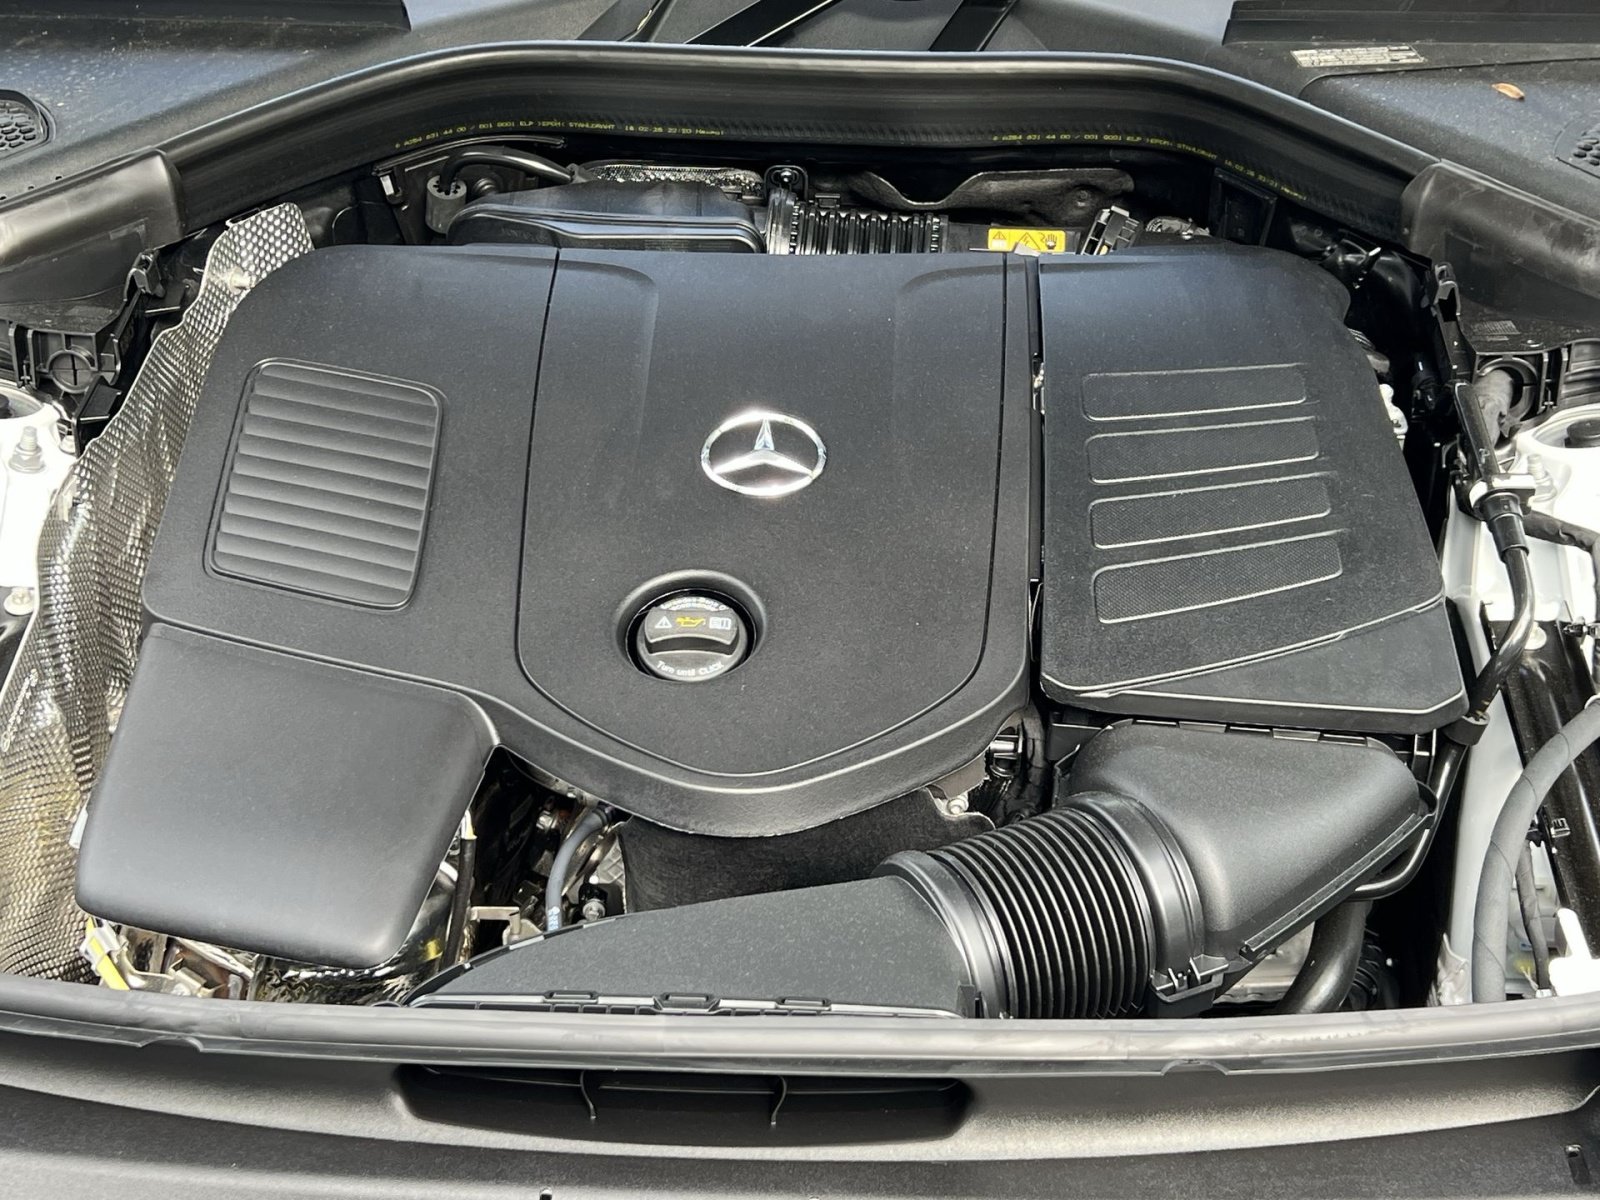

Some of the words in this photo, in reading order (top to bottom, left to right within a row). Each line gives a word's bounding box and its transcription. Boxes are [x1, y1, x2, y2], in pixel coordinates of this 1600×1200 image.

[656, 660, 675, 674] Turn
[676, 668, 696, 676] until
[698, 661, 725, 675] CLICK
